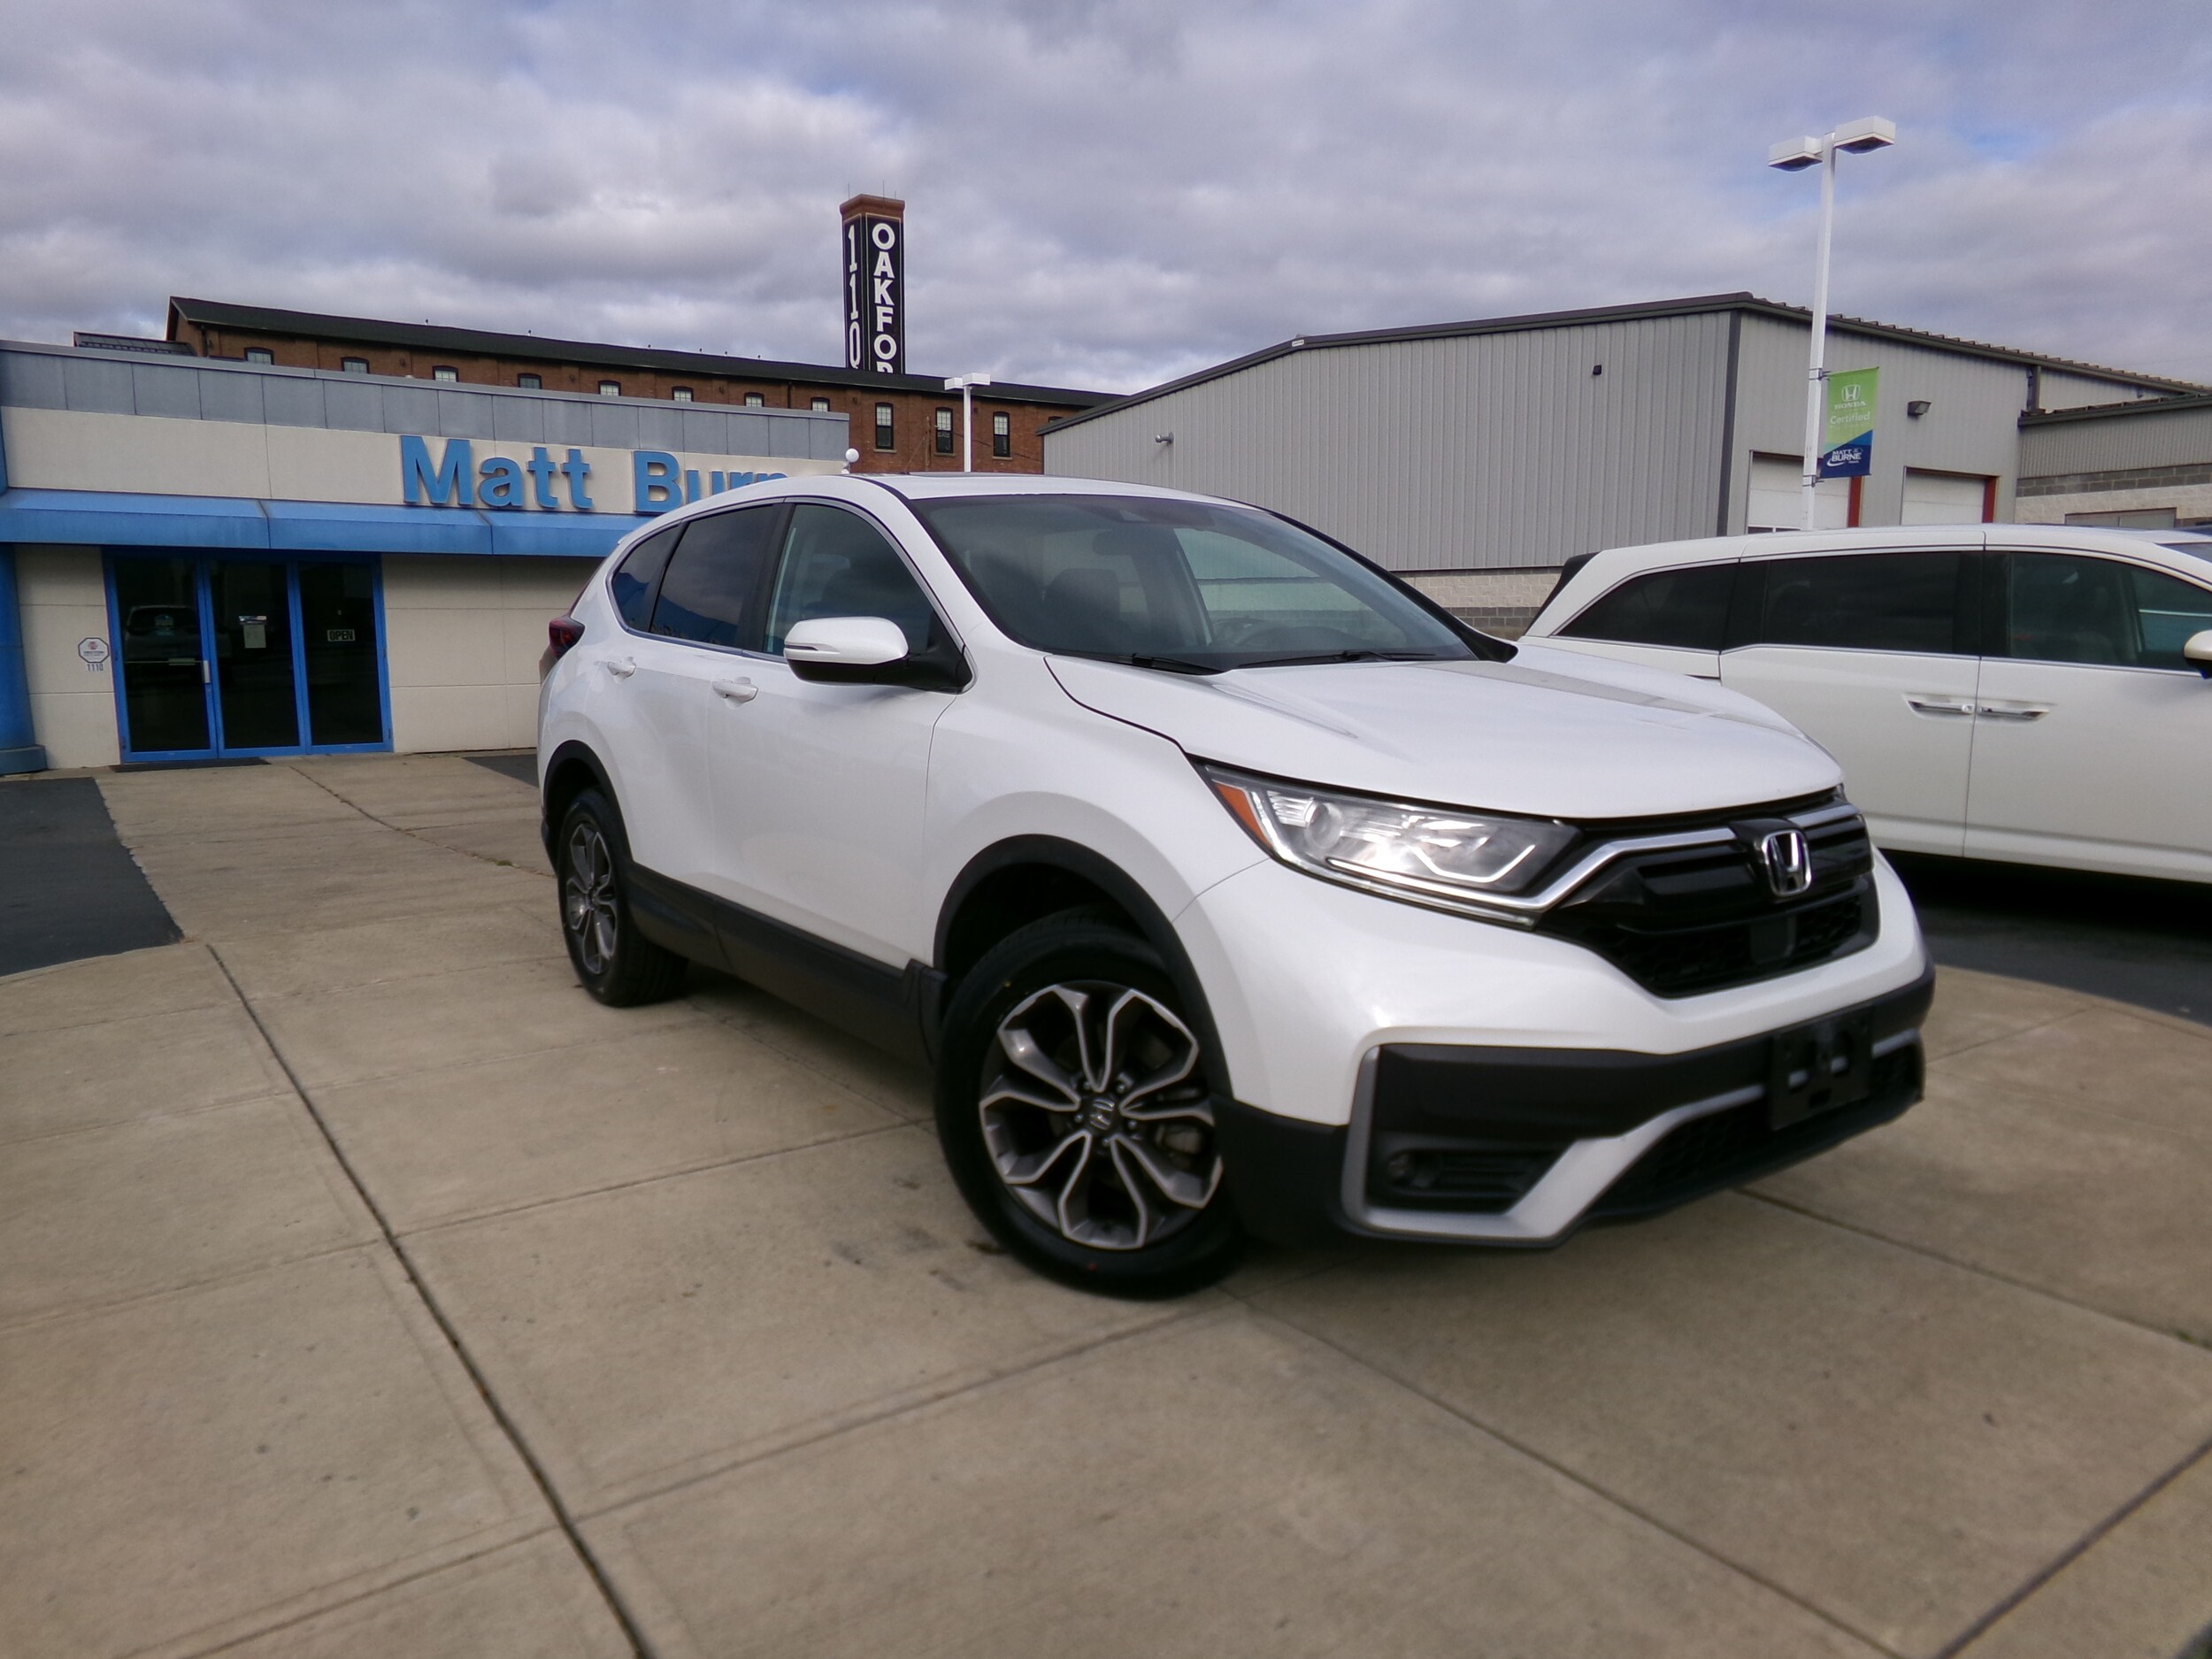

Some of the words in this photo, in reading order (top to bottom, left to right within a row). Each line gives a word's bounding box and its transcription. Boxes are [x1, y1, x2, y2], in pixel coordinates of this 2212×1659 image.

[1831, 411, 1870, 424] Certified
[1832, 452, 1862, 461] BURNE
[399, 434, 594, 510] Matt
[634, 449, 789, 513] Bu
[329, 630, 354, 641] OPEN
